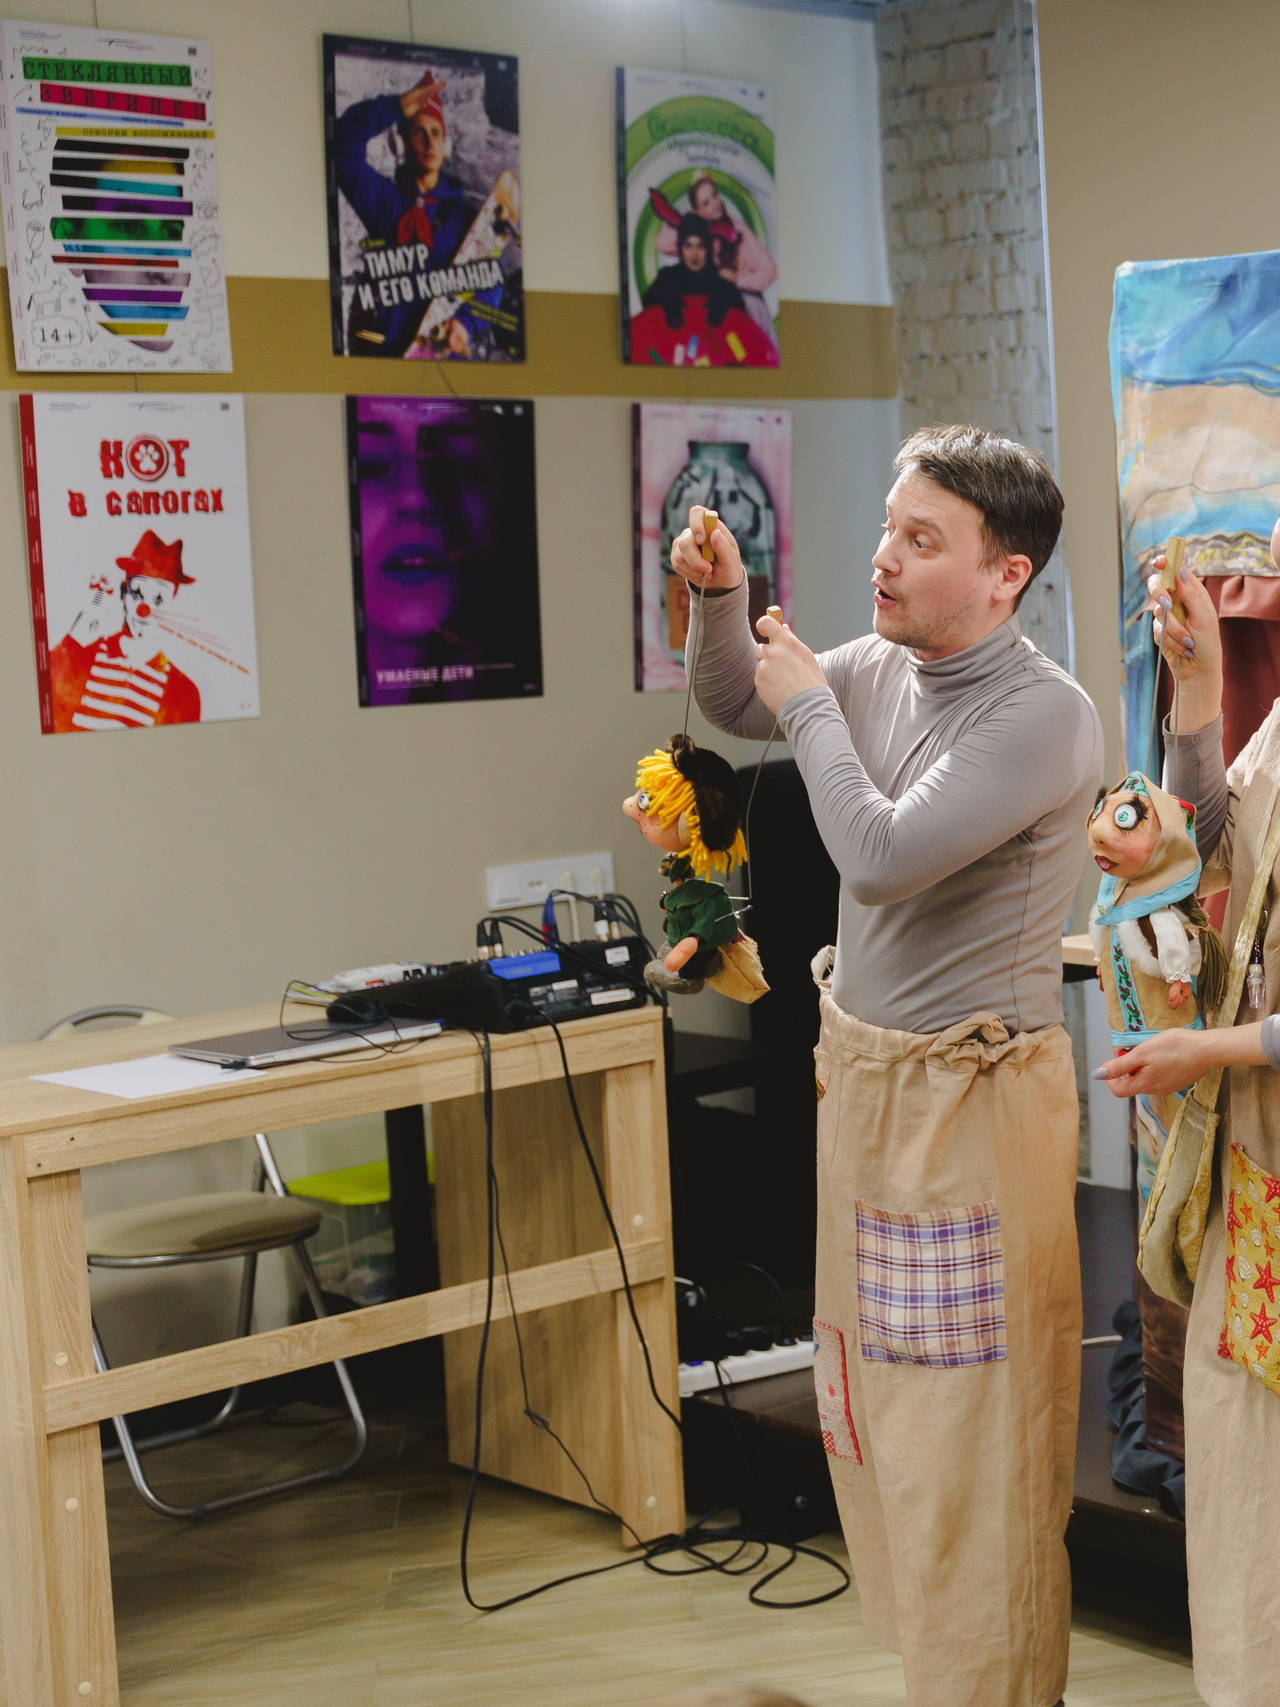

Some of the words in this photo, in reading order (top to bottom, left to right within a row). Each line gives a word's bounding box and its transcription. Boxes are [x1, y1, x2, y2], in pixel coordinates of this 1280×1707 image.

[23, 60, 192, 86] СТЕКЛЯННЫЙ
[363, 242, 430, 280] ТИМУР
[357, 282, 376, 312] И
[378, 275, 415, 307] ЕГО
[416, 258, 505, 300] КОМАНДА
[441, 664, 475, 683] ДЕТИ
